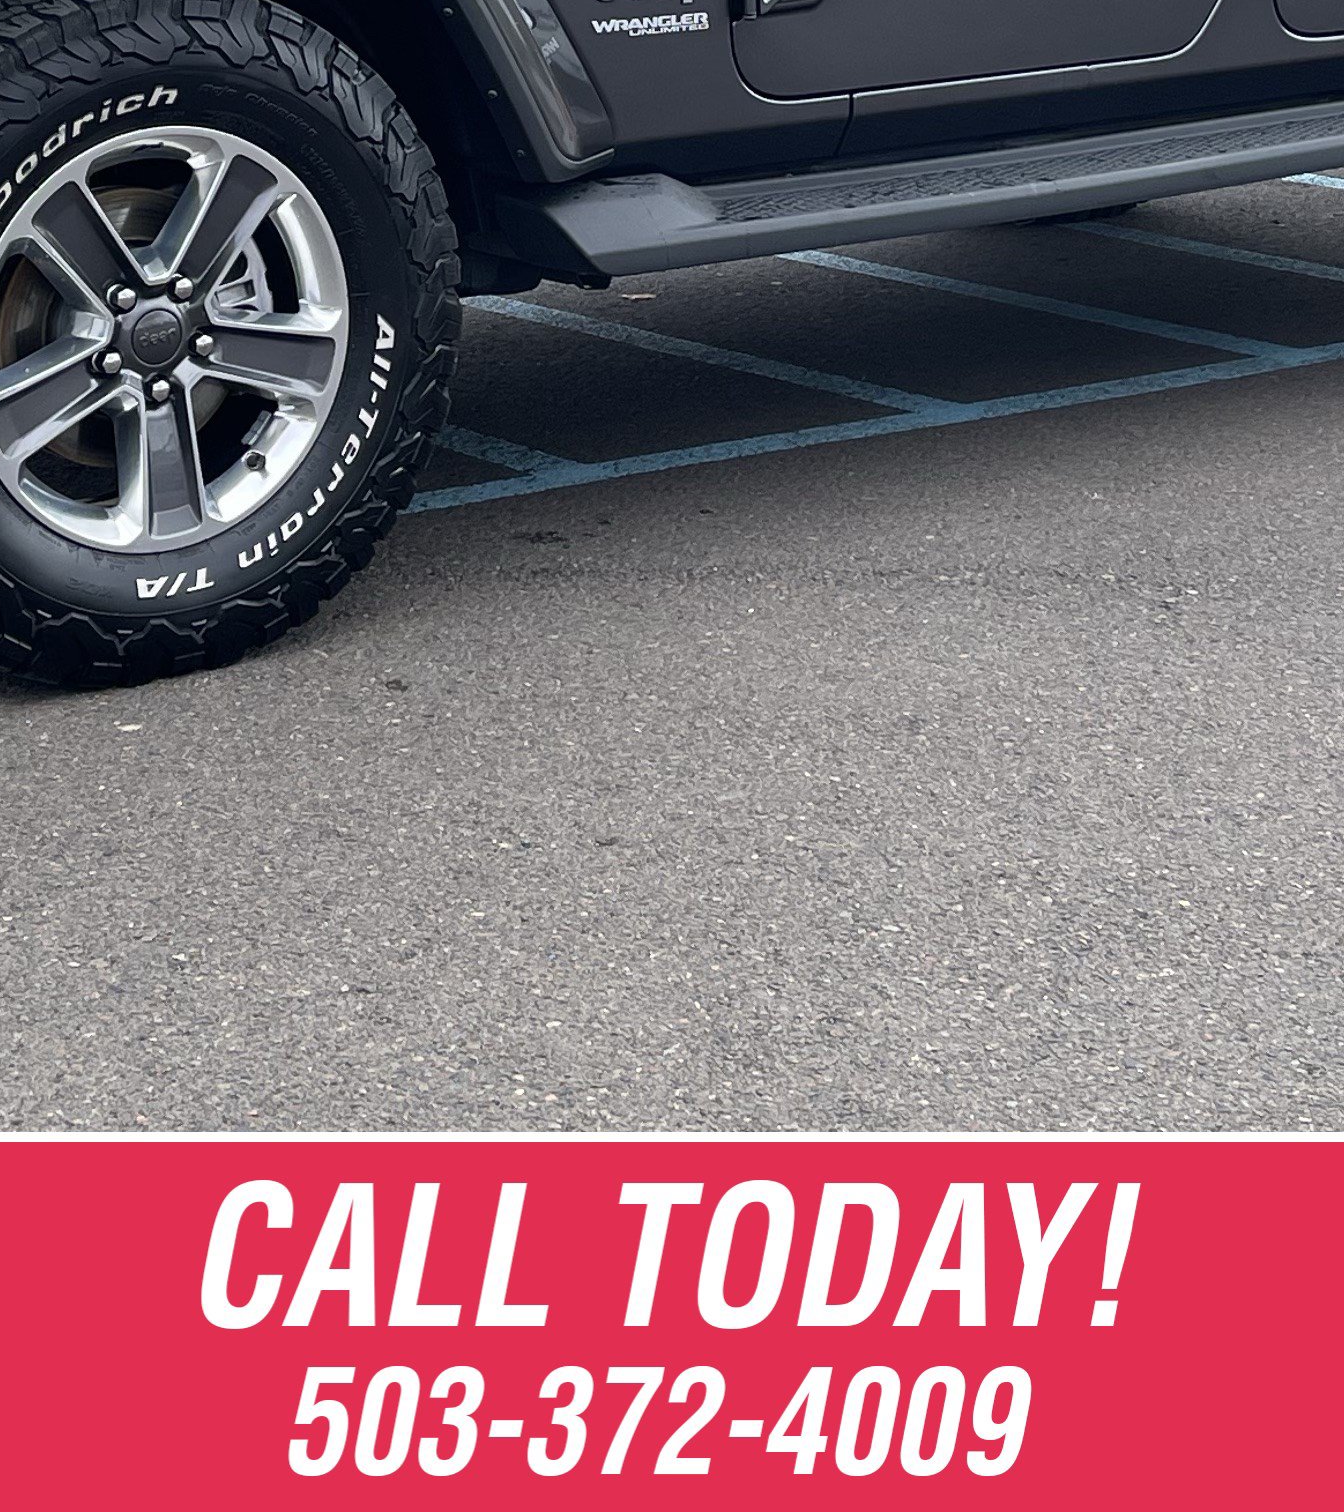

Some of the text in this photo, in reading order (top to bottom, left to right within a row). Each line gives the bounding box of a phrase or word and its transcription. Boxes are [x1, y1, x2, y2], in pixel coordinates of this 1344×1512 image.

[591, 12, 709, 34] WRANGLER
[238, 313, 396, 569] All-Terrain
[135, 566, 216, 600] T/A
